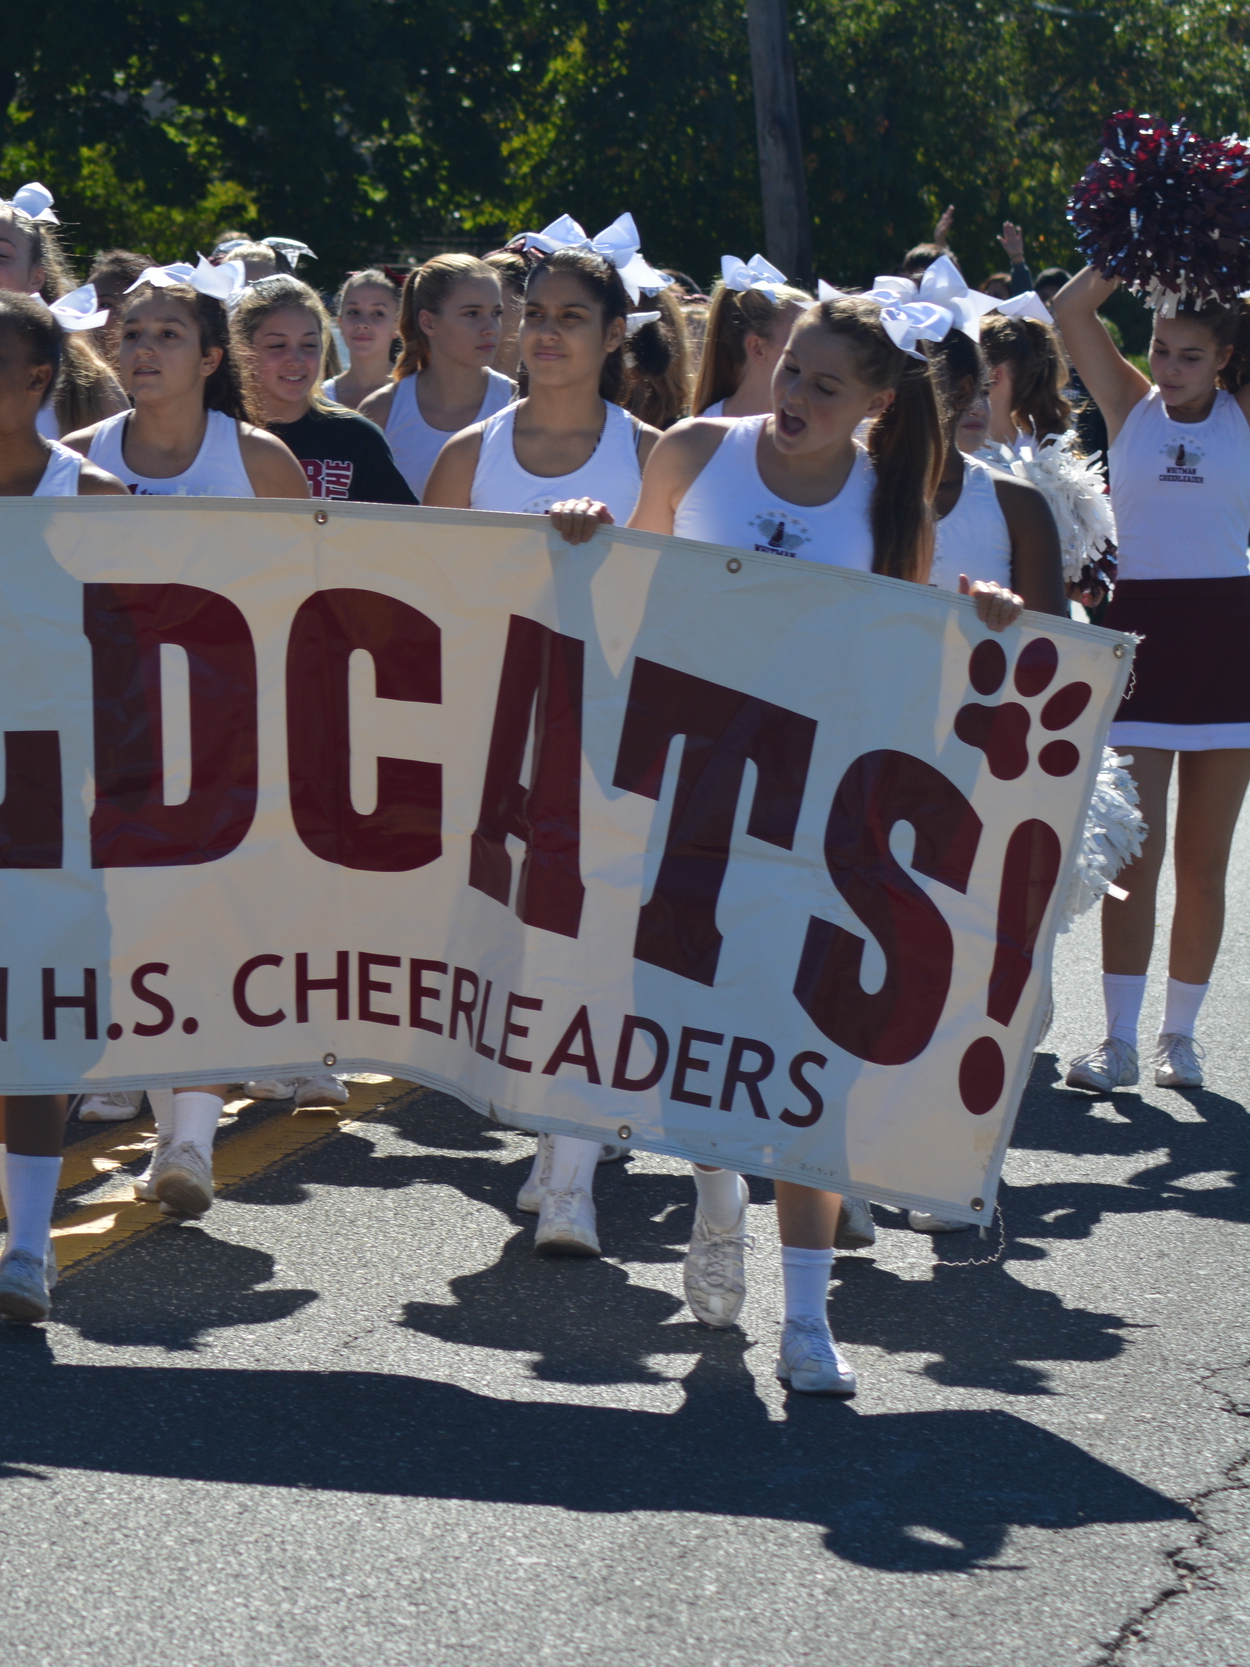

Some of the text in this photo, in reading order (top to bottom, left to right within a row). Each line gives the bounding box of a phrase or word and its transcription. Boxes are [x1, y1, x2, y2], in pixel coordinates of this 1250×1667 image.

[324, 459, 354, 499] THE
[1159, 475, 1204, 483] CHEERLEADER
[1166, 467, 1197, 475] WHITMAN
[41, 962, 200, 1041] H.S.
[232, 950, 829, 1128] CHEERLEADERS
